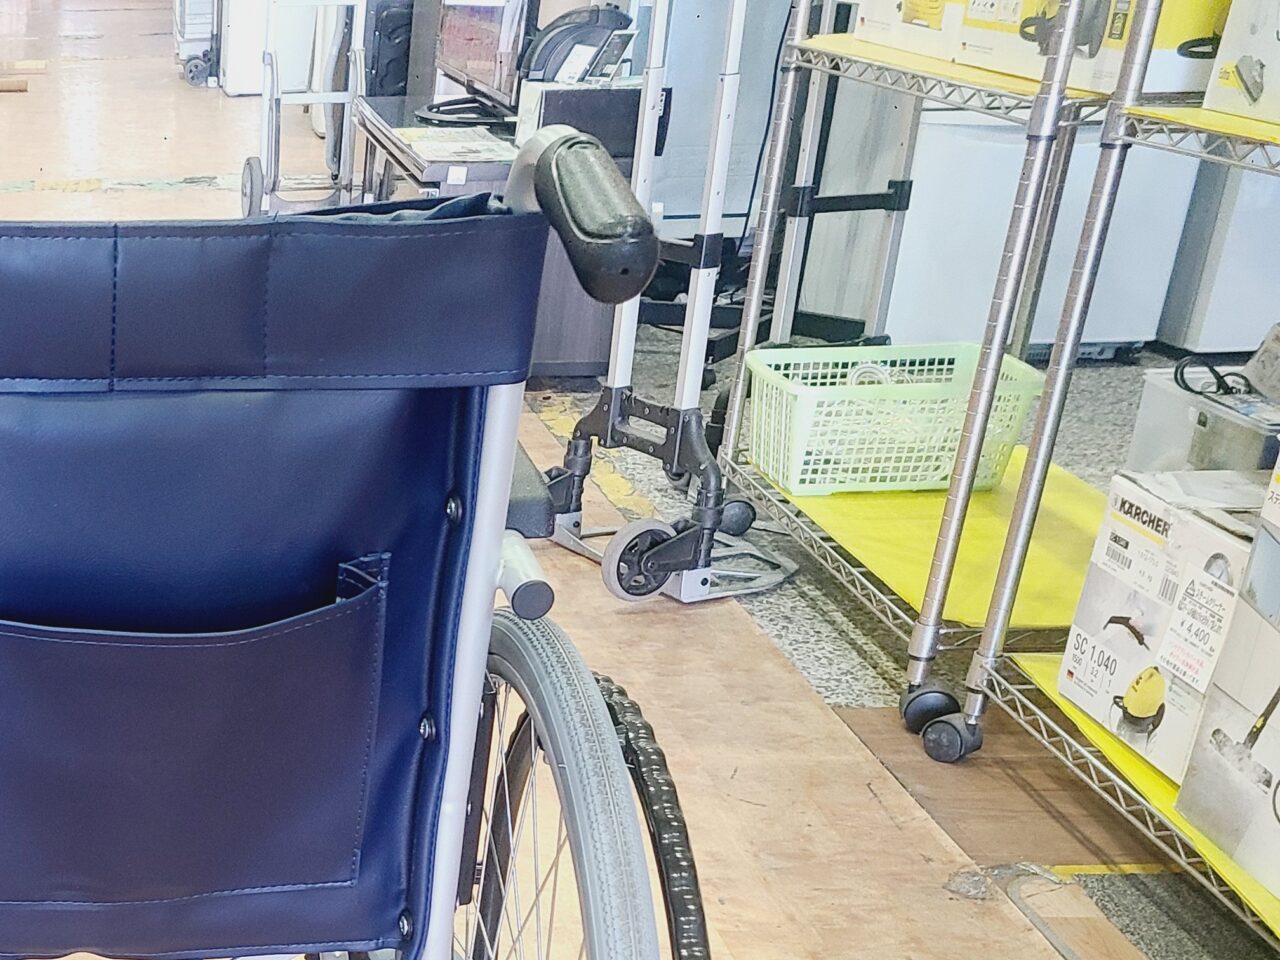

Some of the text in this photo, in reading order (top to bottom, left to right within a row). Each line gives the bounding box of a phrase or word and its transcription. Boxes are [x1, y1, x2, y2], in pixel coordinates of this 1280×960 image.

[1119, 496, 1171, 538] KÄRCHER
[1073, 632, 1118, 676] SC 1.040
